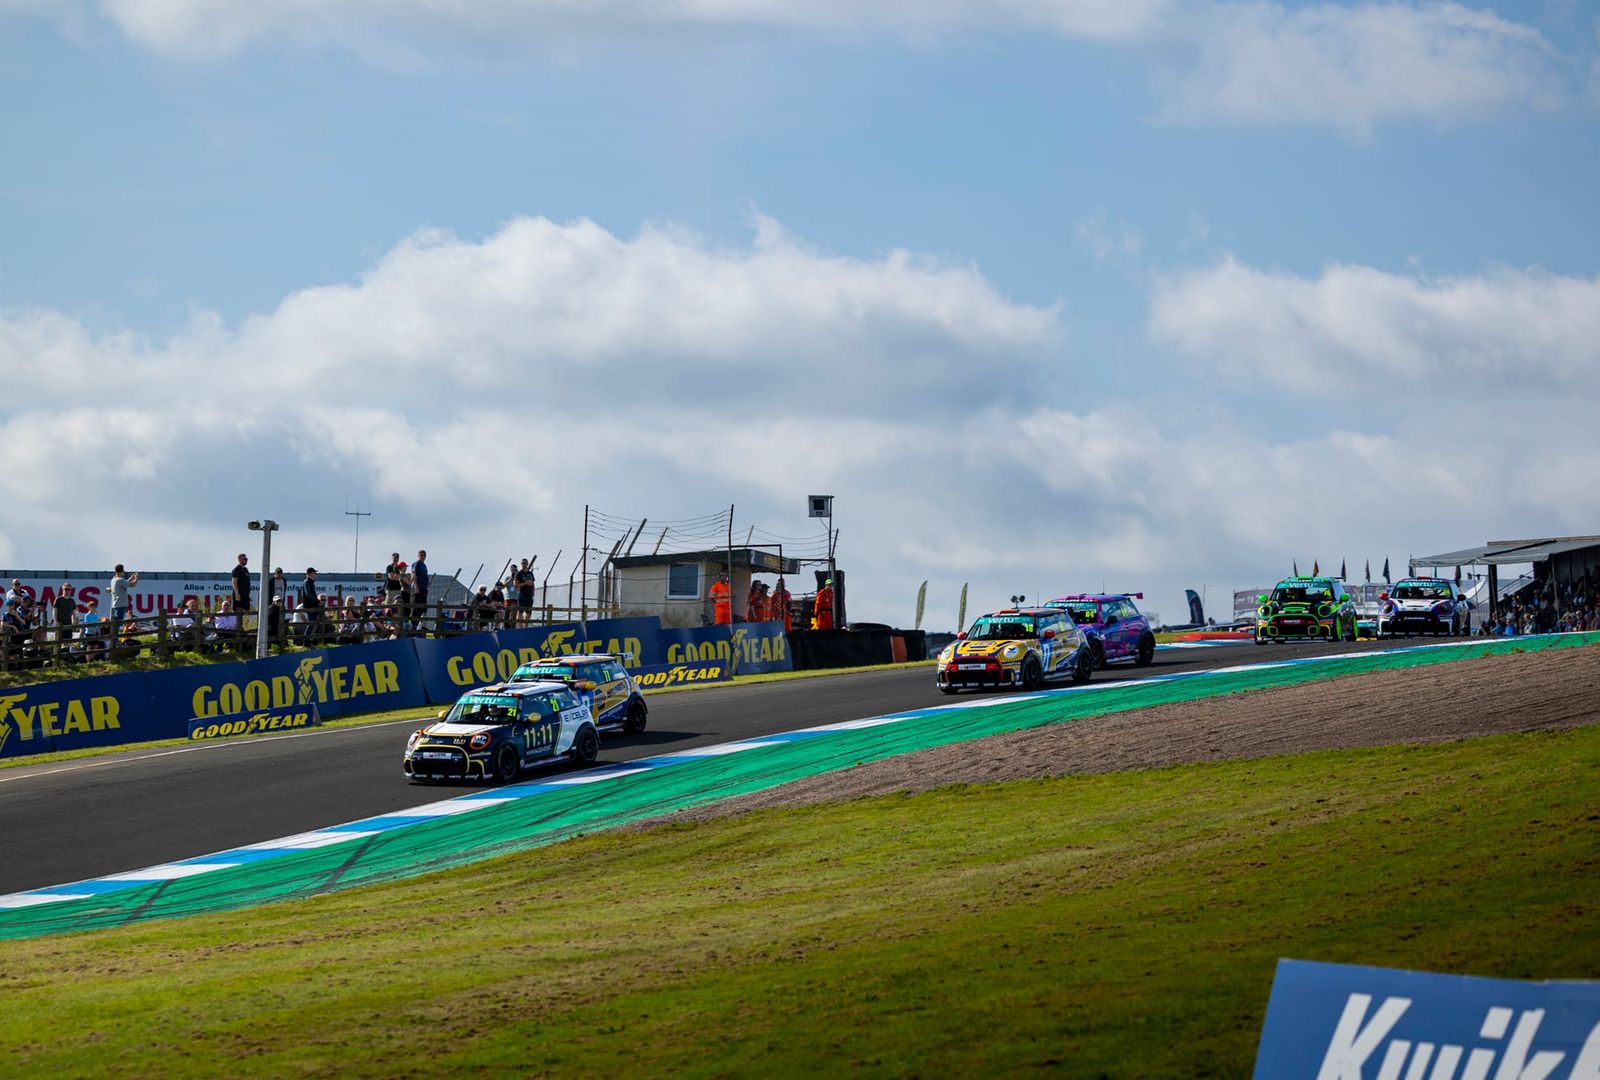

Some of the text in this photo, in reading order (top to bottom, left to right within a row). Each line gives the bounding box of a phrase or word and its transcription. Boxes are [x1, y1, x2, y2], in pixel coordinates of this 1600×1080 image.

[184, 583, 205, 591] Alloa
[525, 667, 552, 675] Vertu
[633, 667, 721, 686] OODYEAR
[469, 696, 497, 704] Vertu
[10, 695, 120, 741] YEAR
[507, 707, 517, 717] 21
[192, 712, 308, 740] GOODYEAR
[523, 723, 553, 749] 11:11
